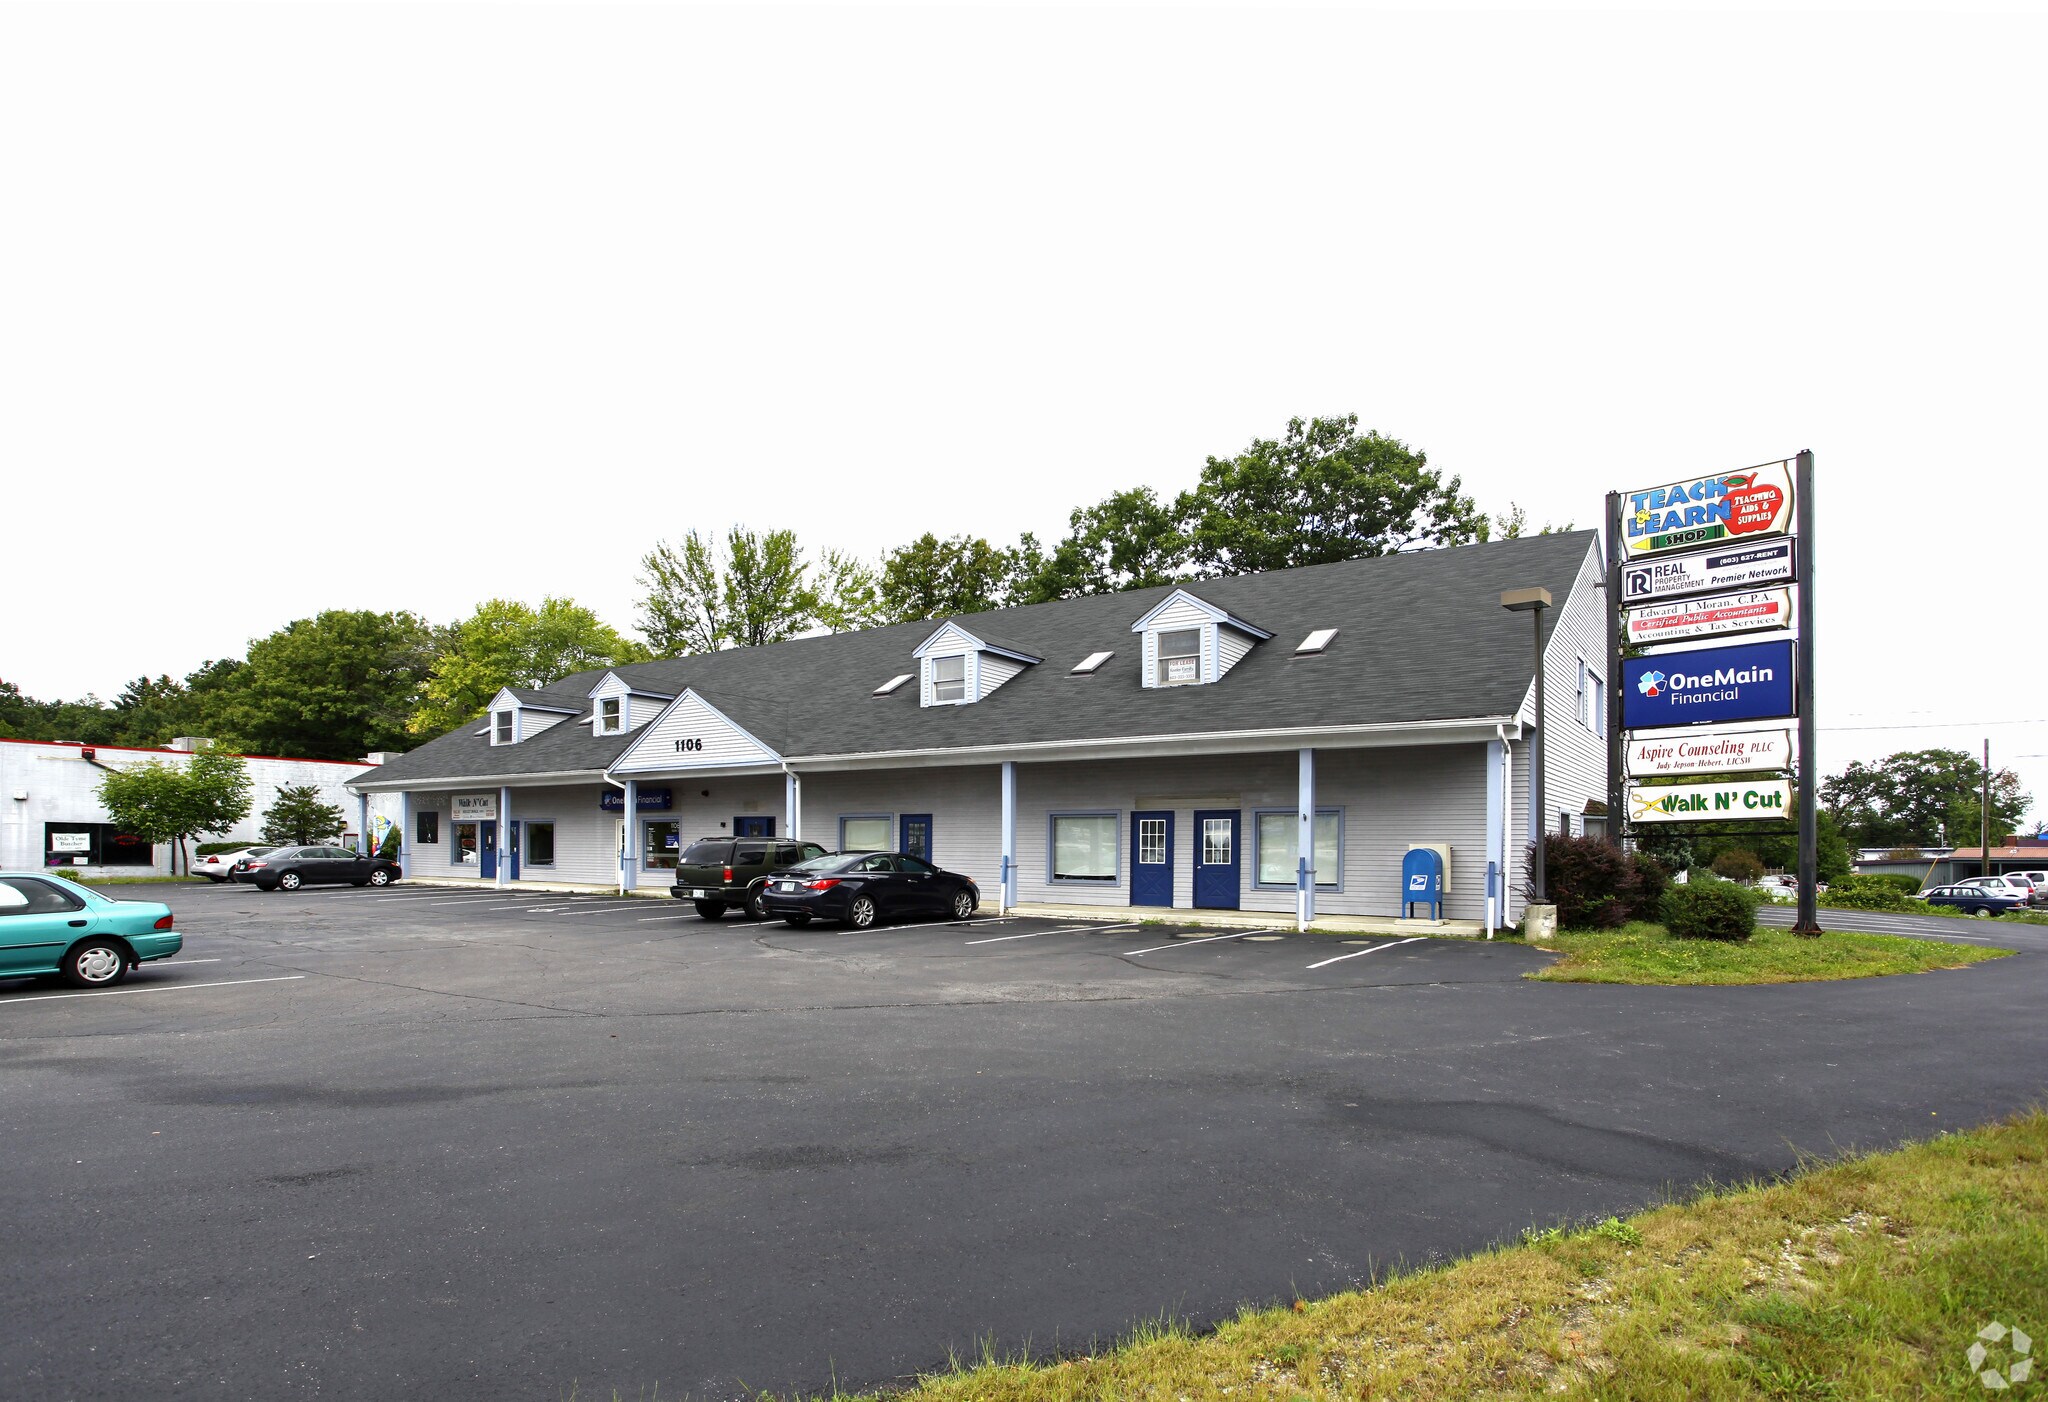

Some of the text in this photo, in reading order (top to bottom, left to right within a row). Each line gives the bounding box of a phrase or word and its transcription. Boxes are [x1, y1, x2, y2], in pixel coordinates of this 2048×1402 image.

[1631, 476, 1728, 512] TEACH
[1734, 490, 1776, 505] TEACHING
[1740, 502, 1769, 514] AIDS &
[1628, 500, 1732, 537] LEARN
[1738, 512, 1772, 525] SUPPLIES
[1666, 530, 1706, 545] SHOP
[1720, 550, 1779, 565] (603) 627-RENT
[1655, 562, 1686, 577] REAL
[1711, 573, 1746, 584] Premier
[1748, 566, 1788, 579] Network
[1655, 574, 1691, 586] PROPERTY
[1655, 579, 1705, 593] MANAGEMENT
[1640, 605, 1678, 618] Edward
[1684, 604, 1691, 614] J.
[1738, 593, 1772, 604] C.P.A.
[1640, 606, 1767, 628] Certified Public Accountants
[1636, 616, 1776, 640] Accounting & Tax Services
[1669, 665, 1773, 690] OneMain
[1671, 687, 1738, 705] Financial
[674, 738, 702, 752] 1106
[1638, 740, 1774, 762] Aspire Counseling PLLC
[1656, 762, 1671, 770] Judy
[638, 795, 662, 803] Financial
[1662, 790, 1782, 812] Walk N' Cut
